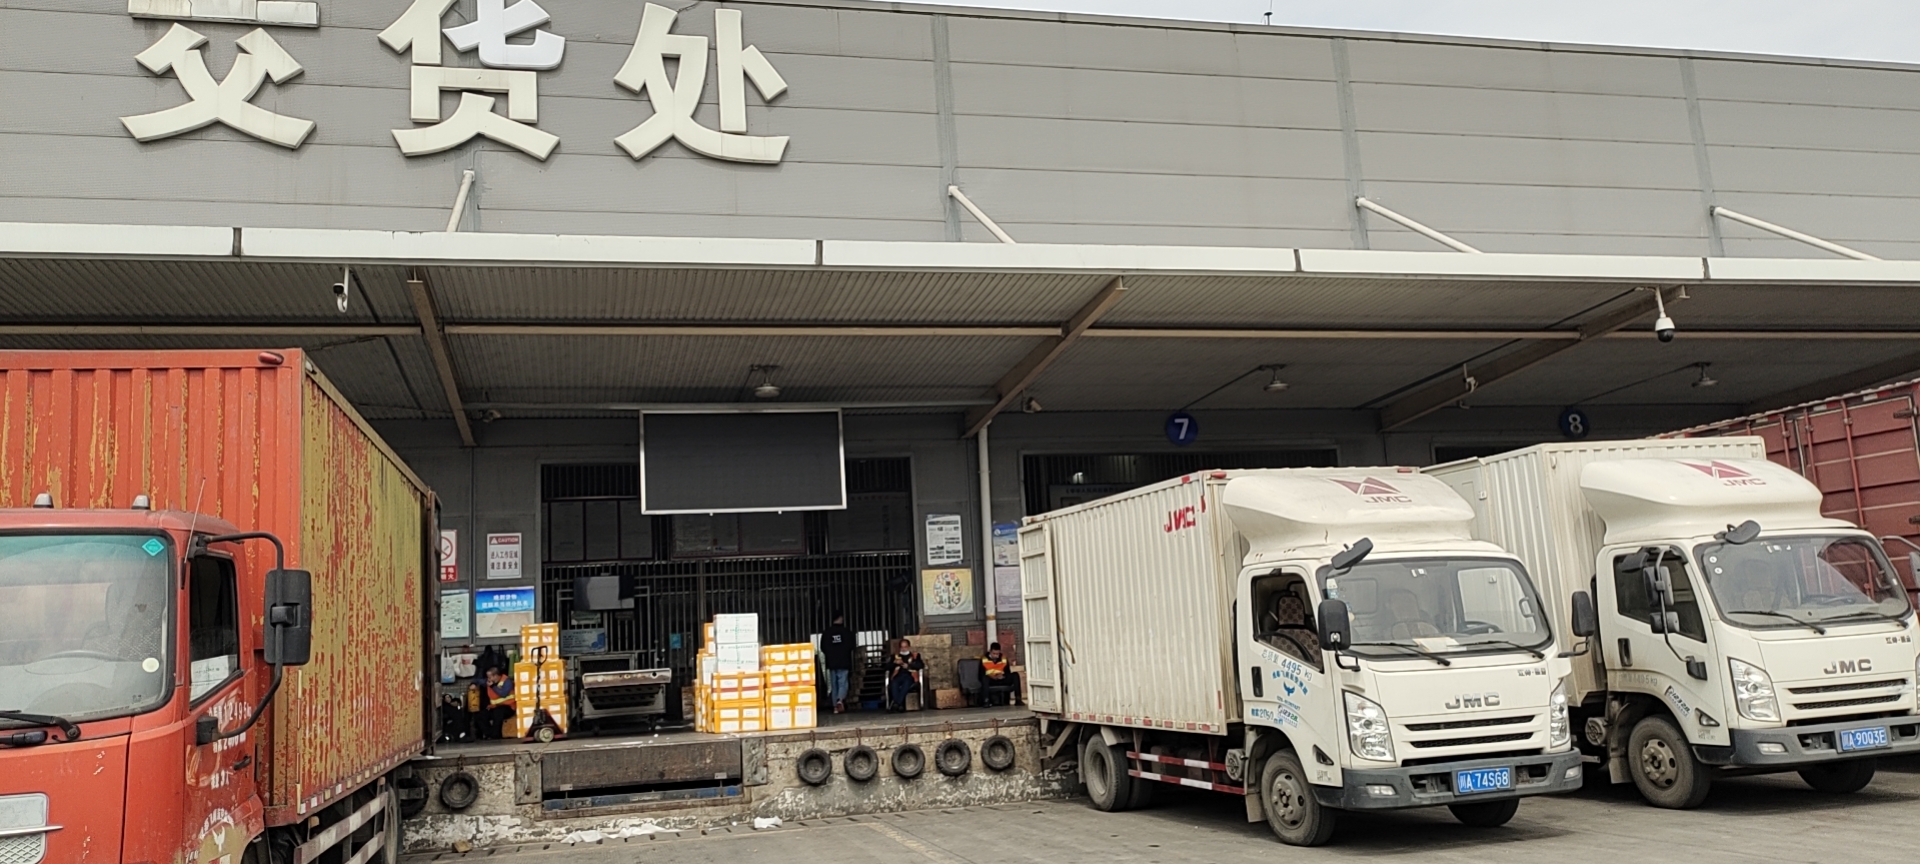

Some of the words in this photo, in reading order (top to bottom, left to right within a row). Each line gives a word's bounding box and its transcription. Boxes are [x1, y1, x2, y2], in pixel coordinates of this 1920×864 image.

[120, 0, 790, 165] 交货处
[1174, 418, 1189, 440] 7
[1568, 413, 1583, 435] 8
[1723, 477, 1767, 487] JMC
[1364, 495, 1412, 504] JMC
[490, 550, 519, 560] 进入工作区域
[490, 560, 519, 571] 请注意安全
[1281, 658, 1303, 676] 4495
[1304, 669, 1313, 681] kg
[1823, 658, 1872, 675] JMC
[1444, 692, 1501, 710] JMC
[1459, 771, 1510, 790] 川A·74SG8
